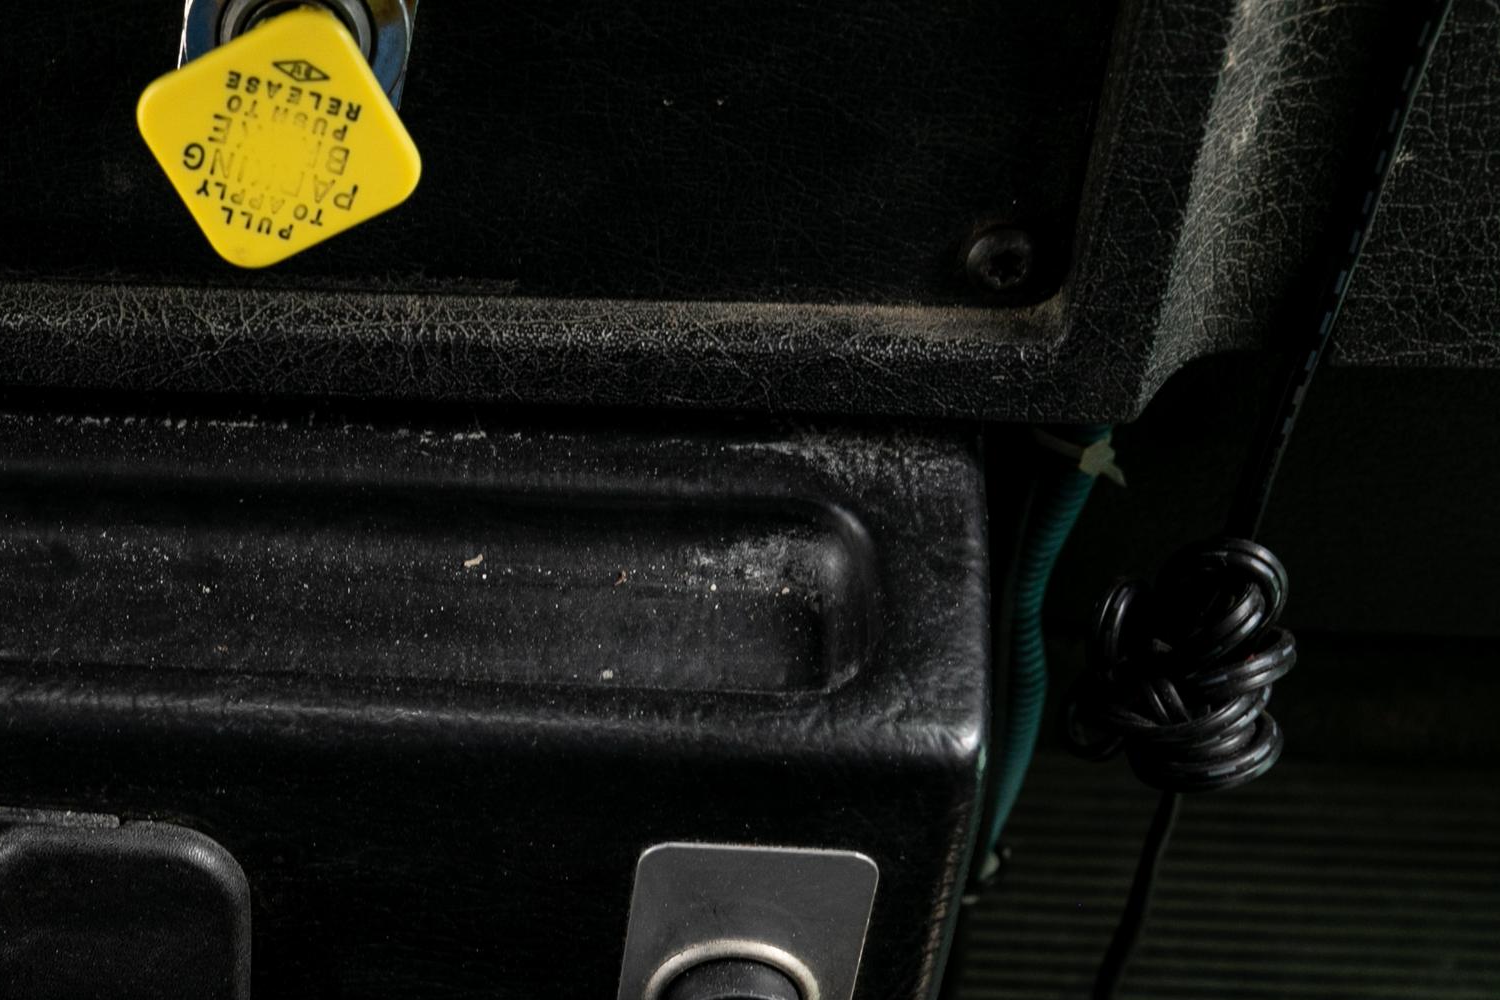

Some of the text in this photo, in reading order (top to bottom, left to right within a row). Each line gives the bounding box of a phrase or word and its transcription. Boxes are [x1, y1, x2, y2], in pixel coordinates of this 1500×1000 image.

[225, 70, 362, 122] RELEASE
[226, 94, 258, 119] TO
[196, 179, 325, 227] TO APPLY
[221, 205, 294, 241] PULL
